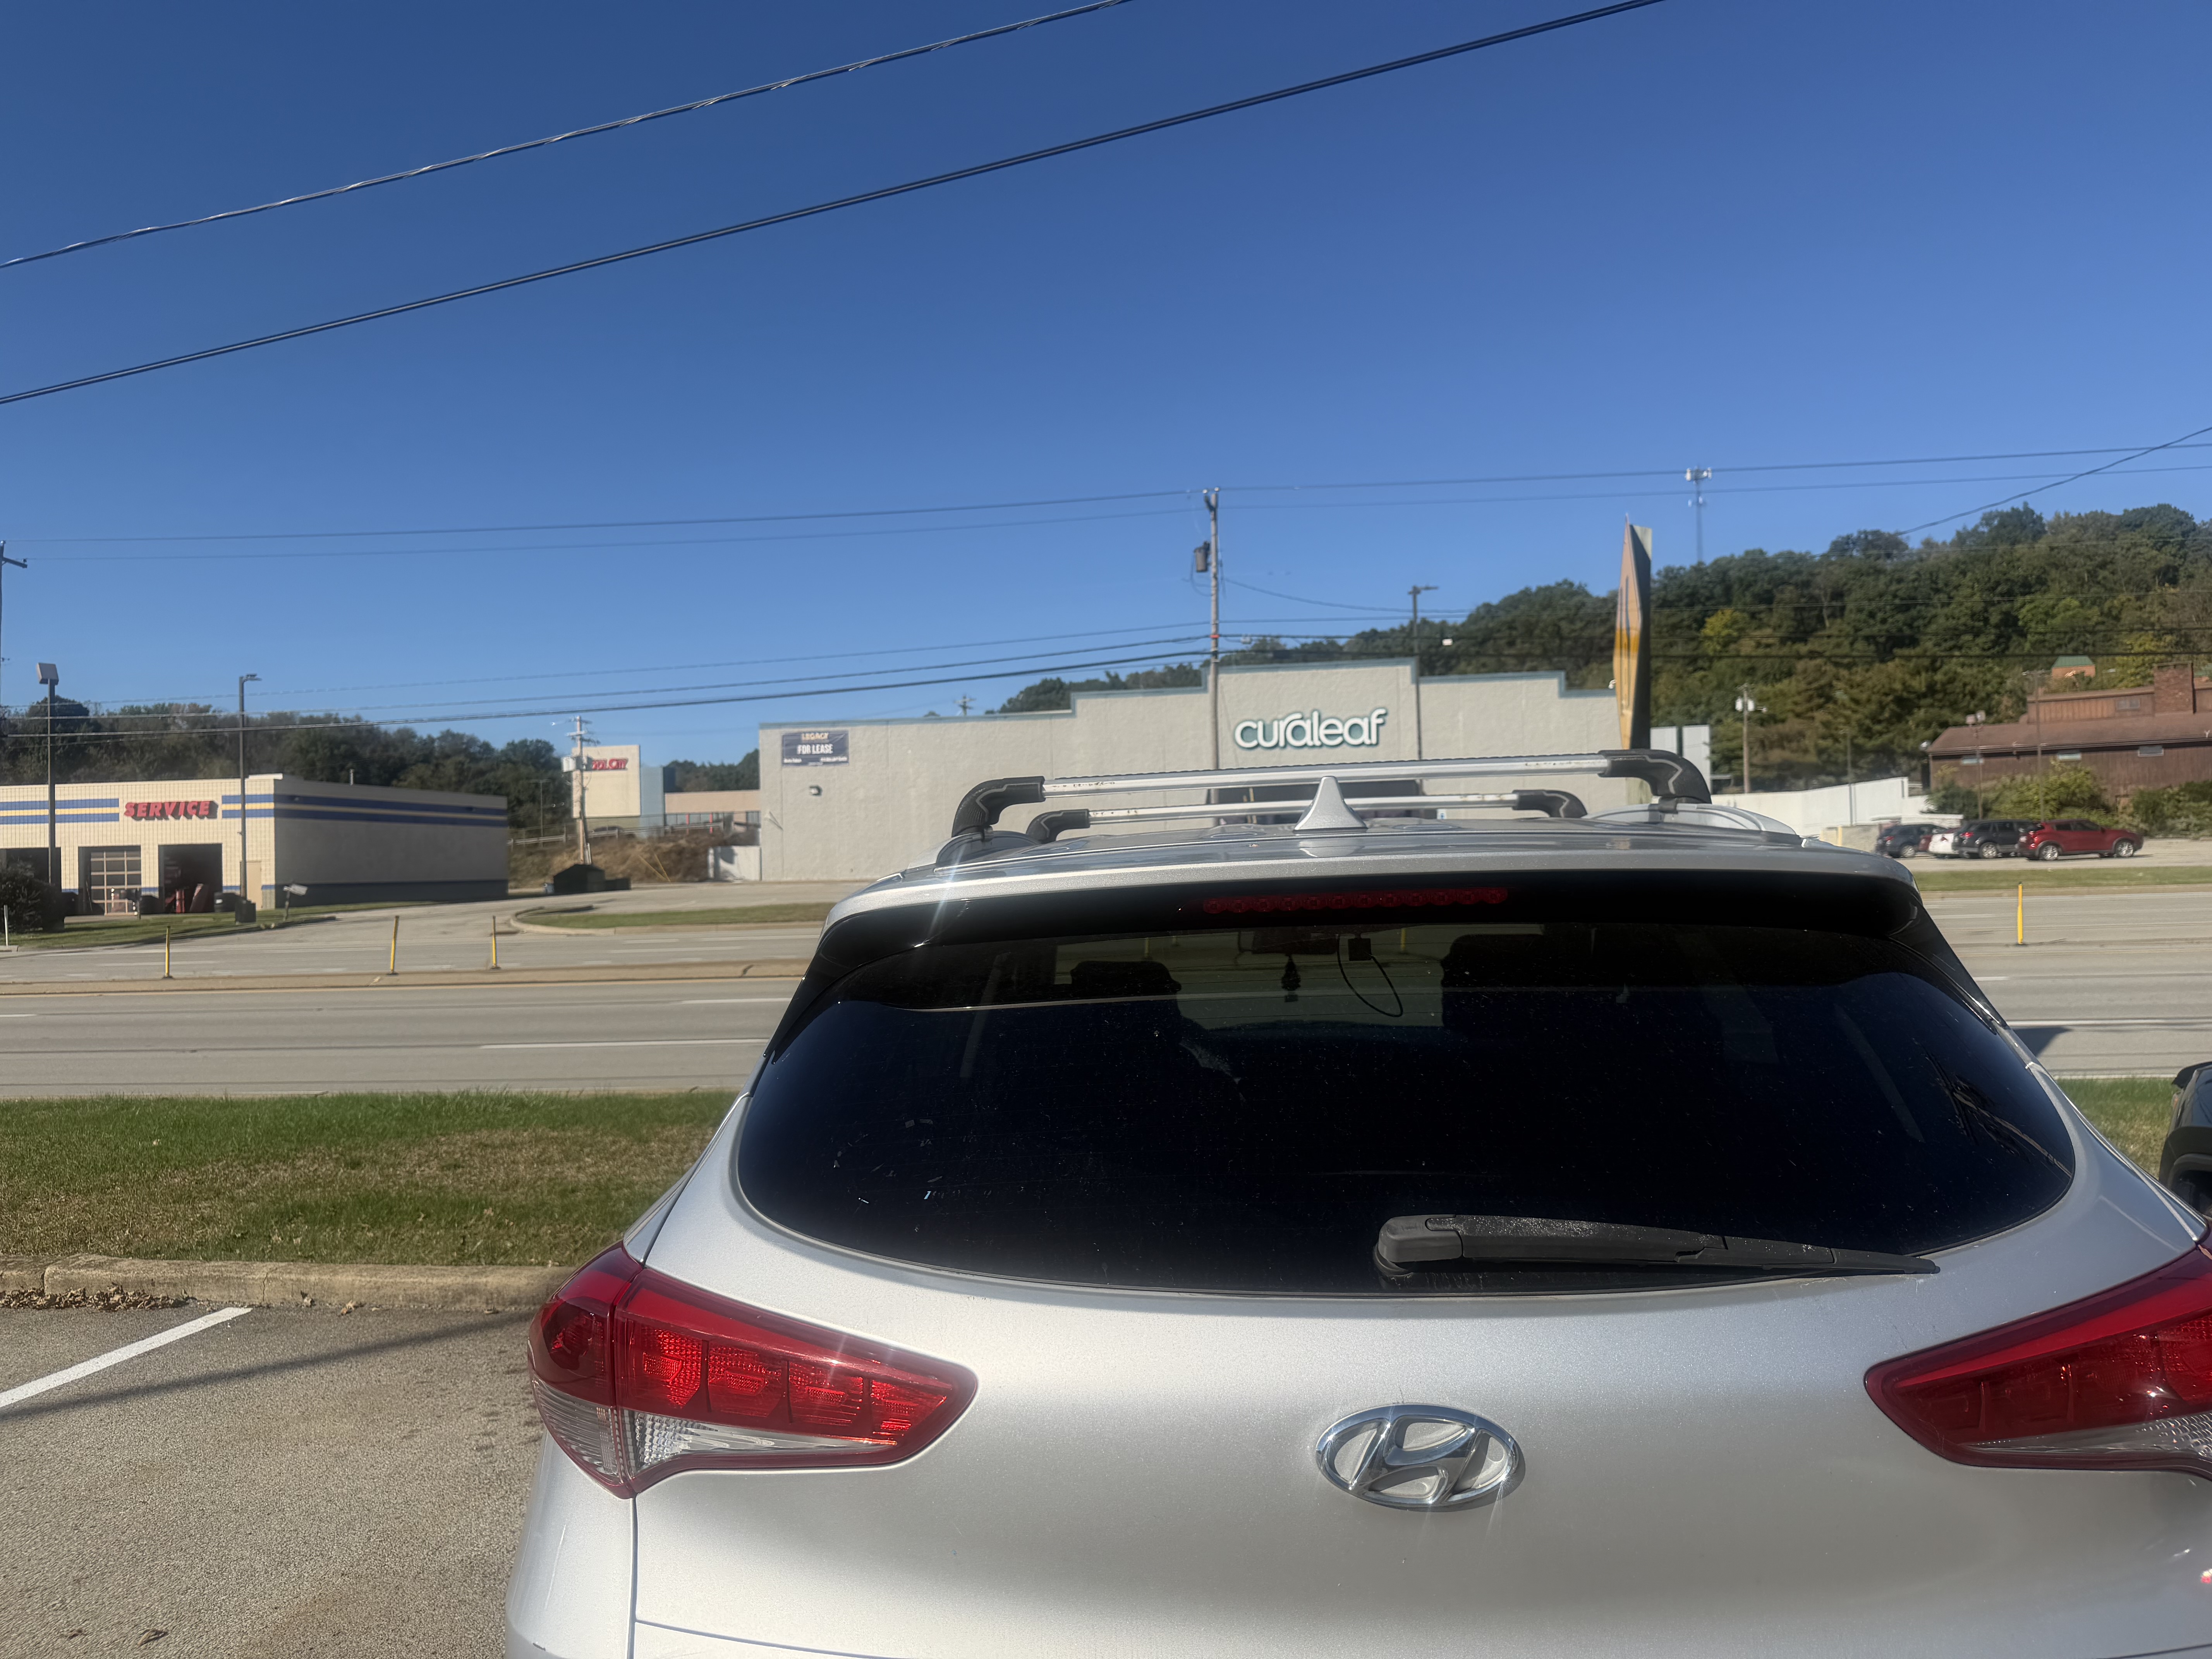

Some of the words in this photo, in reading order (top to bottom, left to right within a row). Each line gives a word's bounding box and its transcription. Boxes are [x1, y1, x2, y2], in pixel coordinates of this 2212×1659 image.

[1235, 708, 1387, 748] curaleaf
[797, 744, 811, 754] FOR
[812, 744, 833, 754] LEASE
[124, 800, 211, 818] SERVICE
